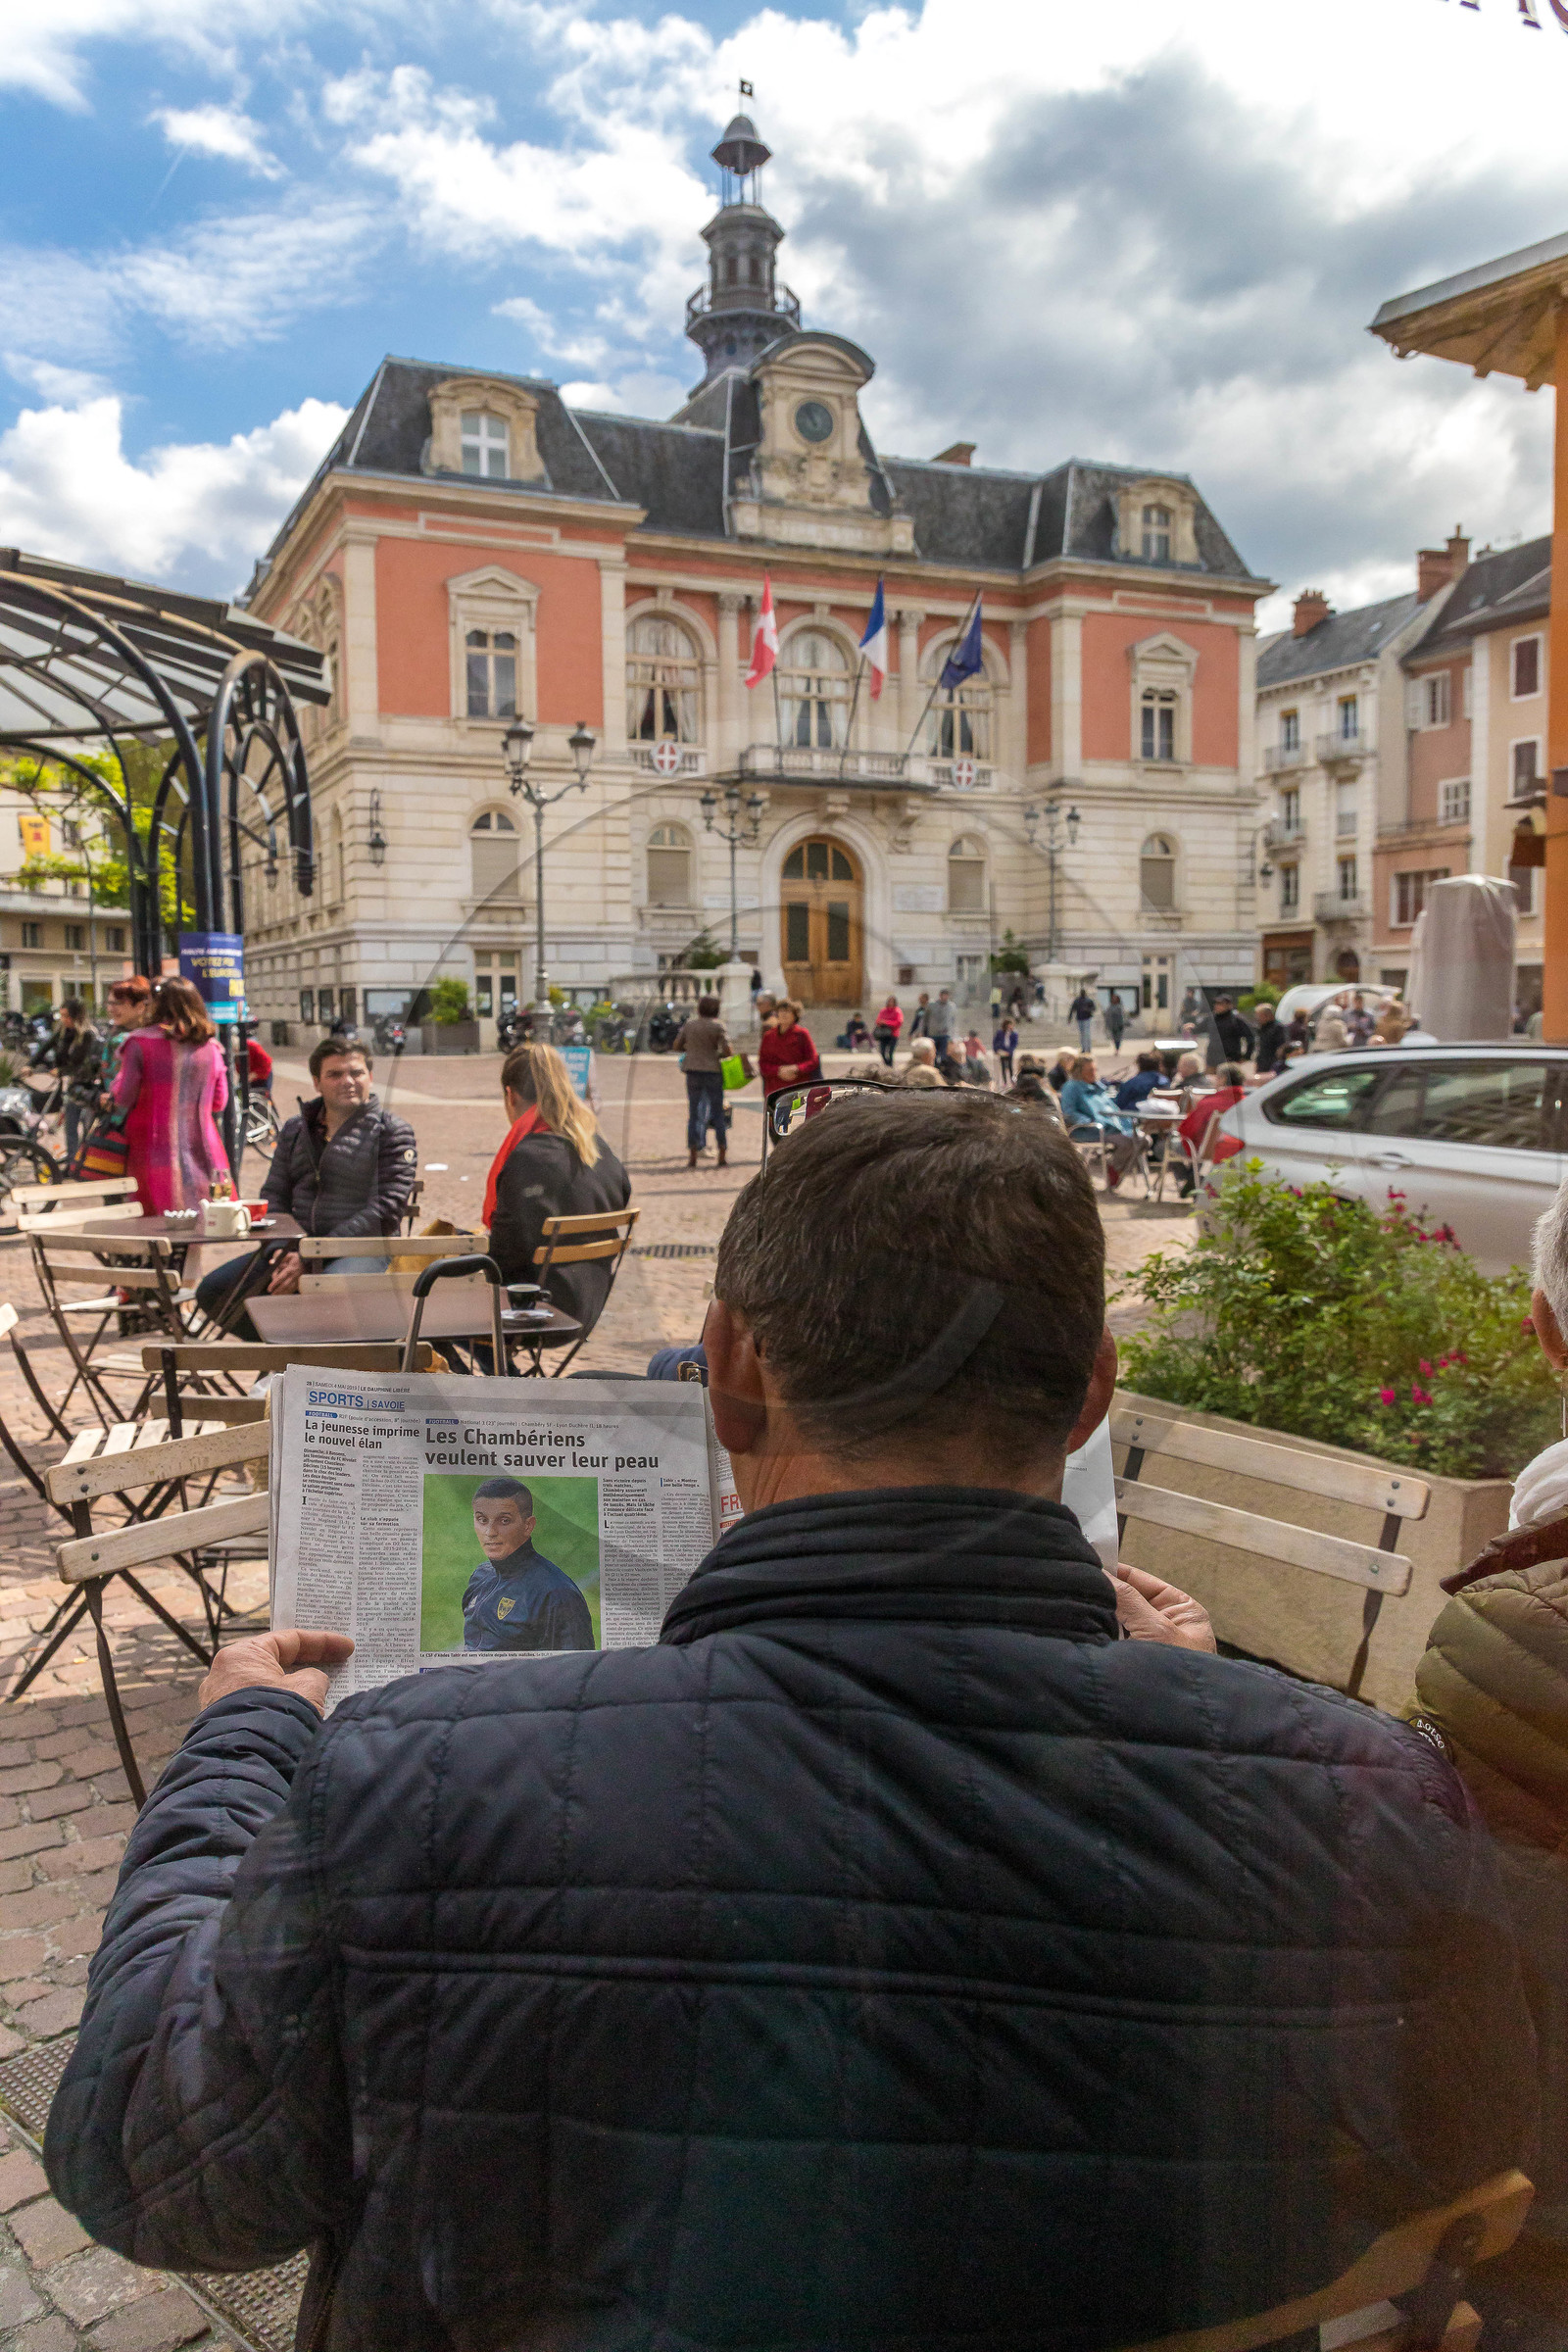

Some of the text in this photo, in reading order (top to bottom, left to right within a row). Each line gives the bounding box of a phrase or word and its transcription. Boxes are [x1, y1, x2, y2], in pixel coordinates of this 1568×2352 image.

[309, 1390, 405, 1409] SPORTS SAVOIE
[306, 1420, 420, 1439] La jeunesse imprime
[426, 1428, 585, 1447] Les Chambériens
[305, 1432, 382, 1449] le nouvel élan
[425, 1448, 659, 1472] veulent sauver leur peau
[720, 1494, 744, 1514] FR
